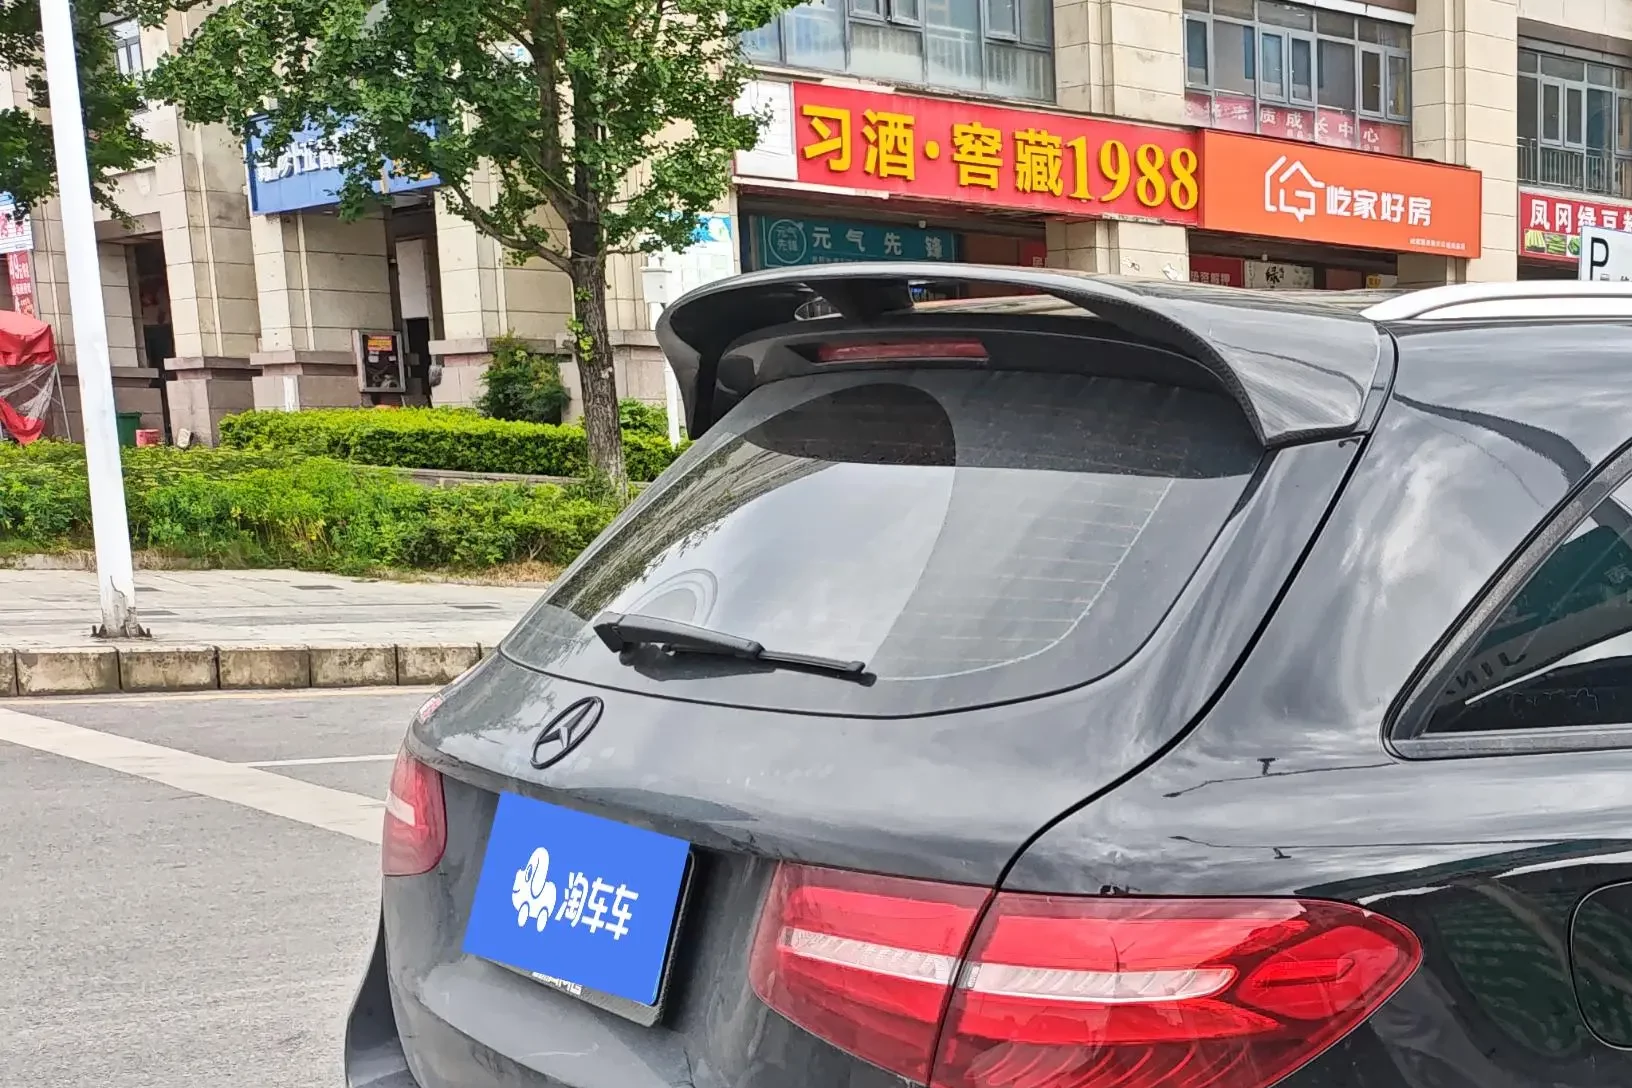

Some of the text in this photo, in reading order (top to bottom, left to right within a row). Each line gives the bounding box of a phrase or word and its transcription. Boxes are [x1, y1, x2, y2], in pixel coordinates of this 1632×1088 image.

[801, 104, 1199, 211] 习酒·窖藏1988
[1326, 185, 1432, 226] 屹家好房
[812, 227, 943, 260] 元气先锋
[1590, 237, 1610, 280] P
